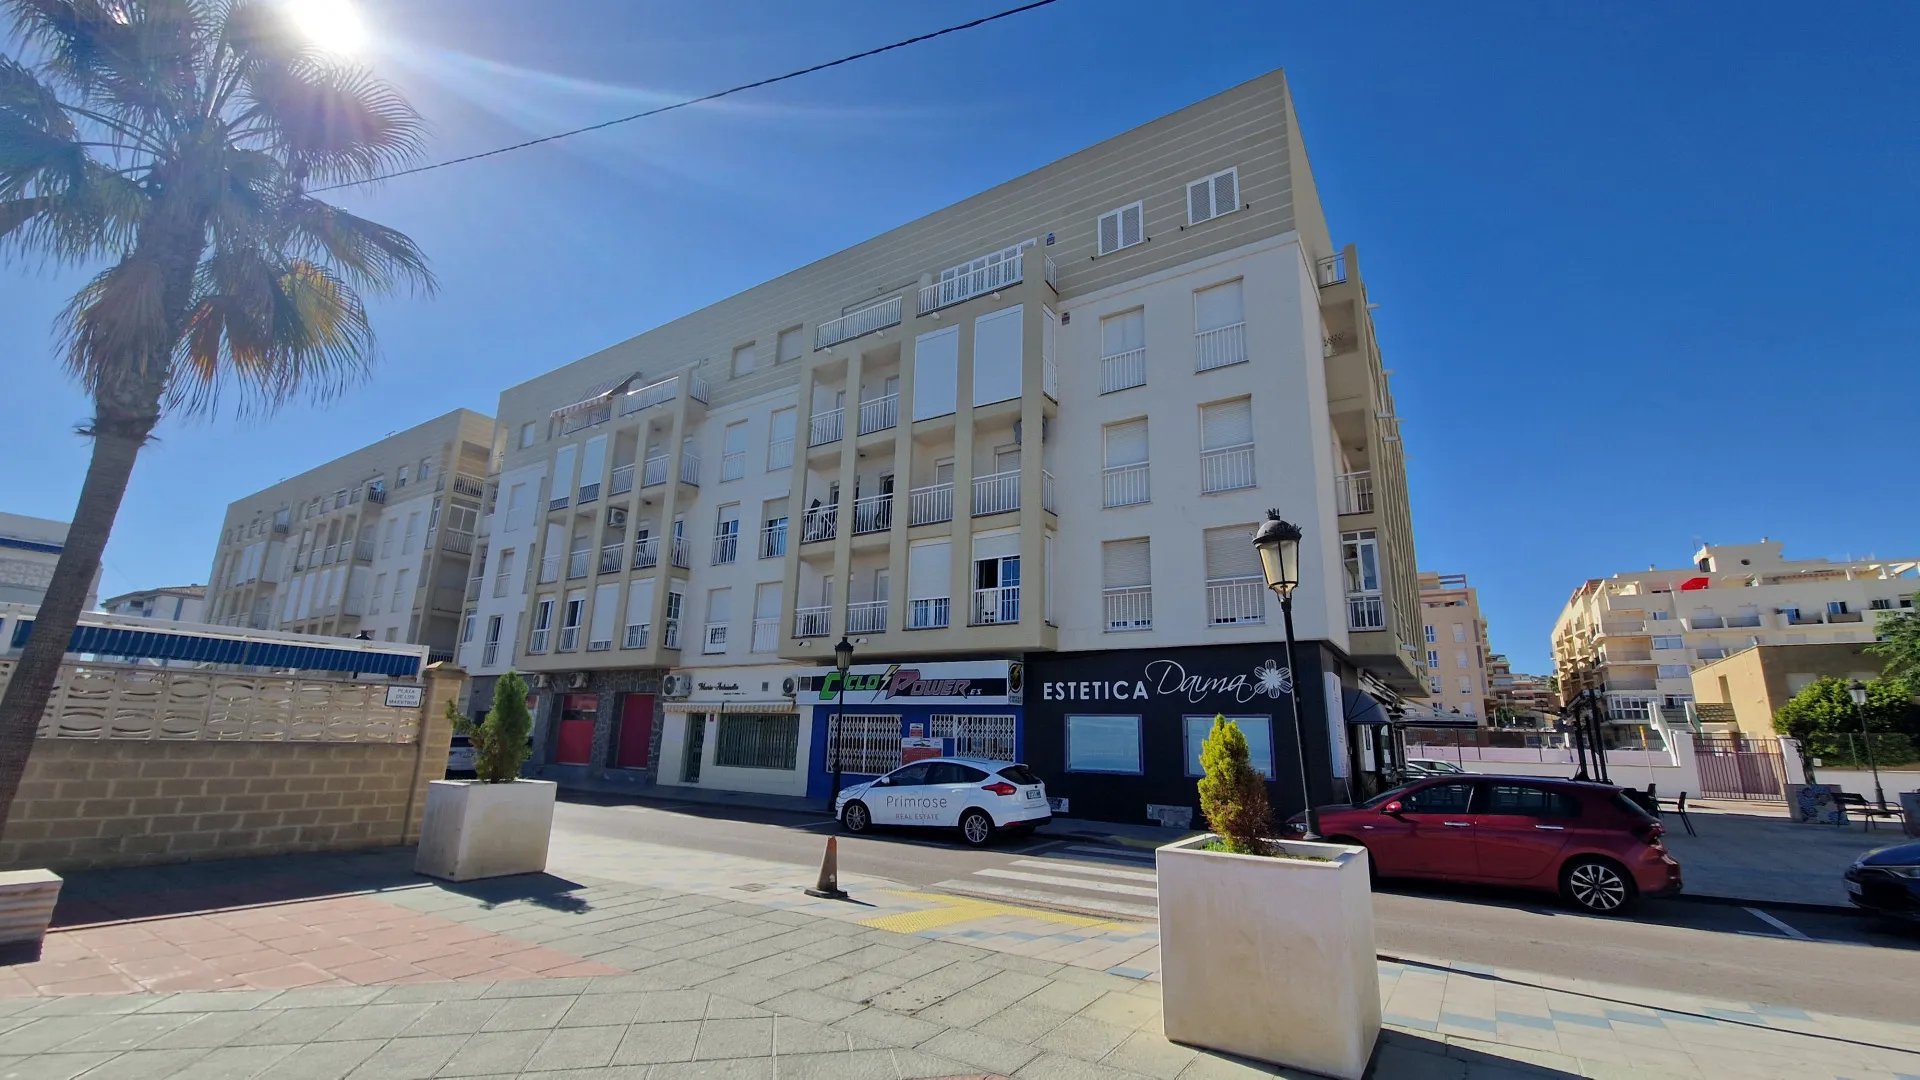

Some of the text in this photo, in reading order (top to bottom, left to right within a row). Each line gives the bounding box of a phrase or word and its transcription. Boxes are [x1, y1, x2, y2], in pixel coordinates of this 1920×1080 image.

[1043, 680, 1149, 701] ESTETICA
[886, 795, 948, 809] Primrose
[896, 813, 939, 821] REAL ESTATE
